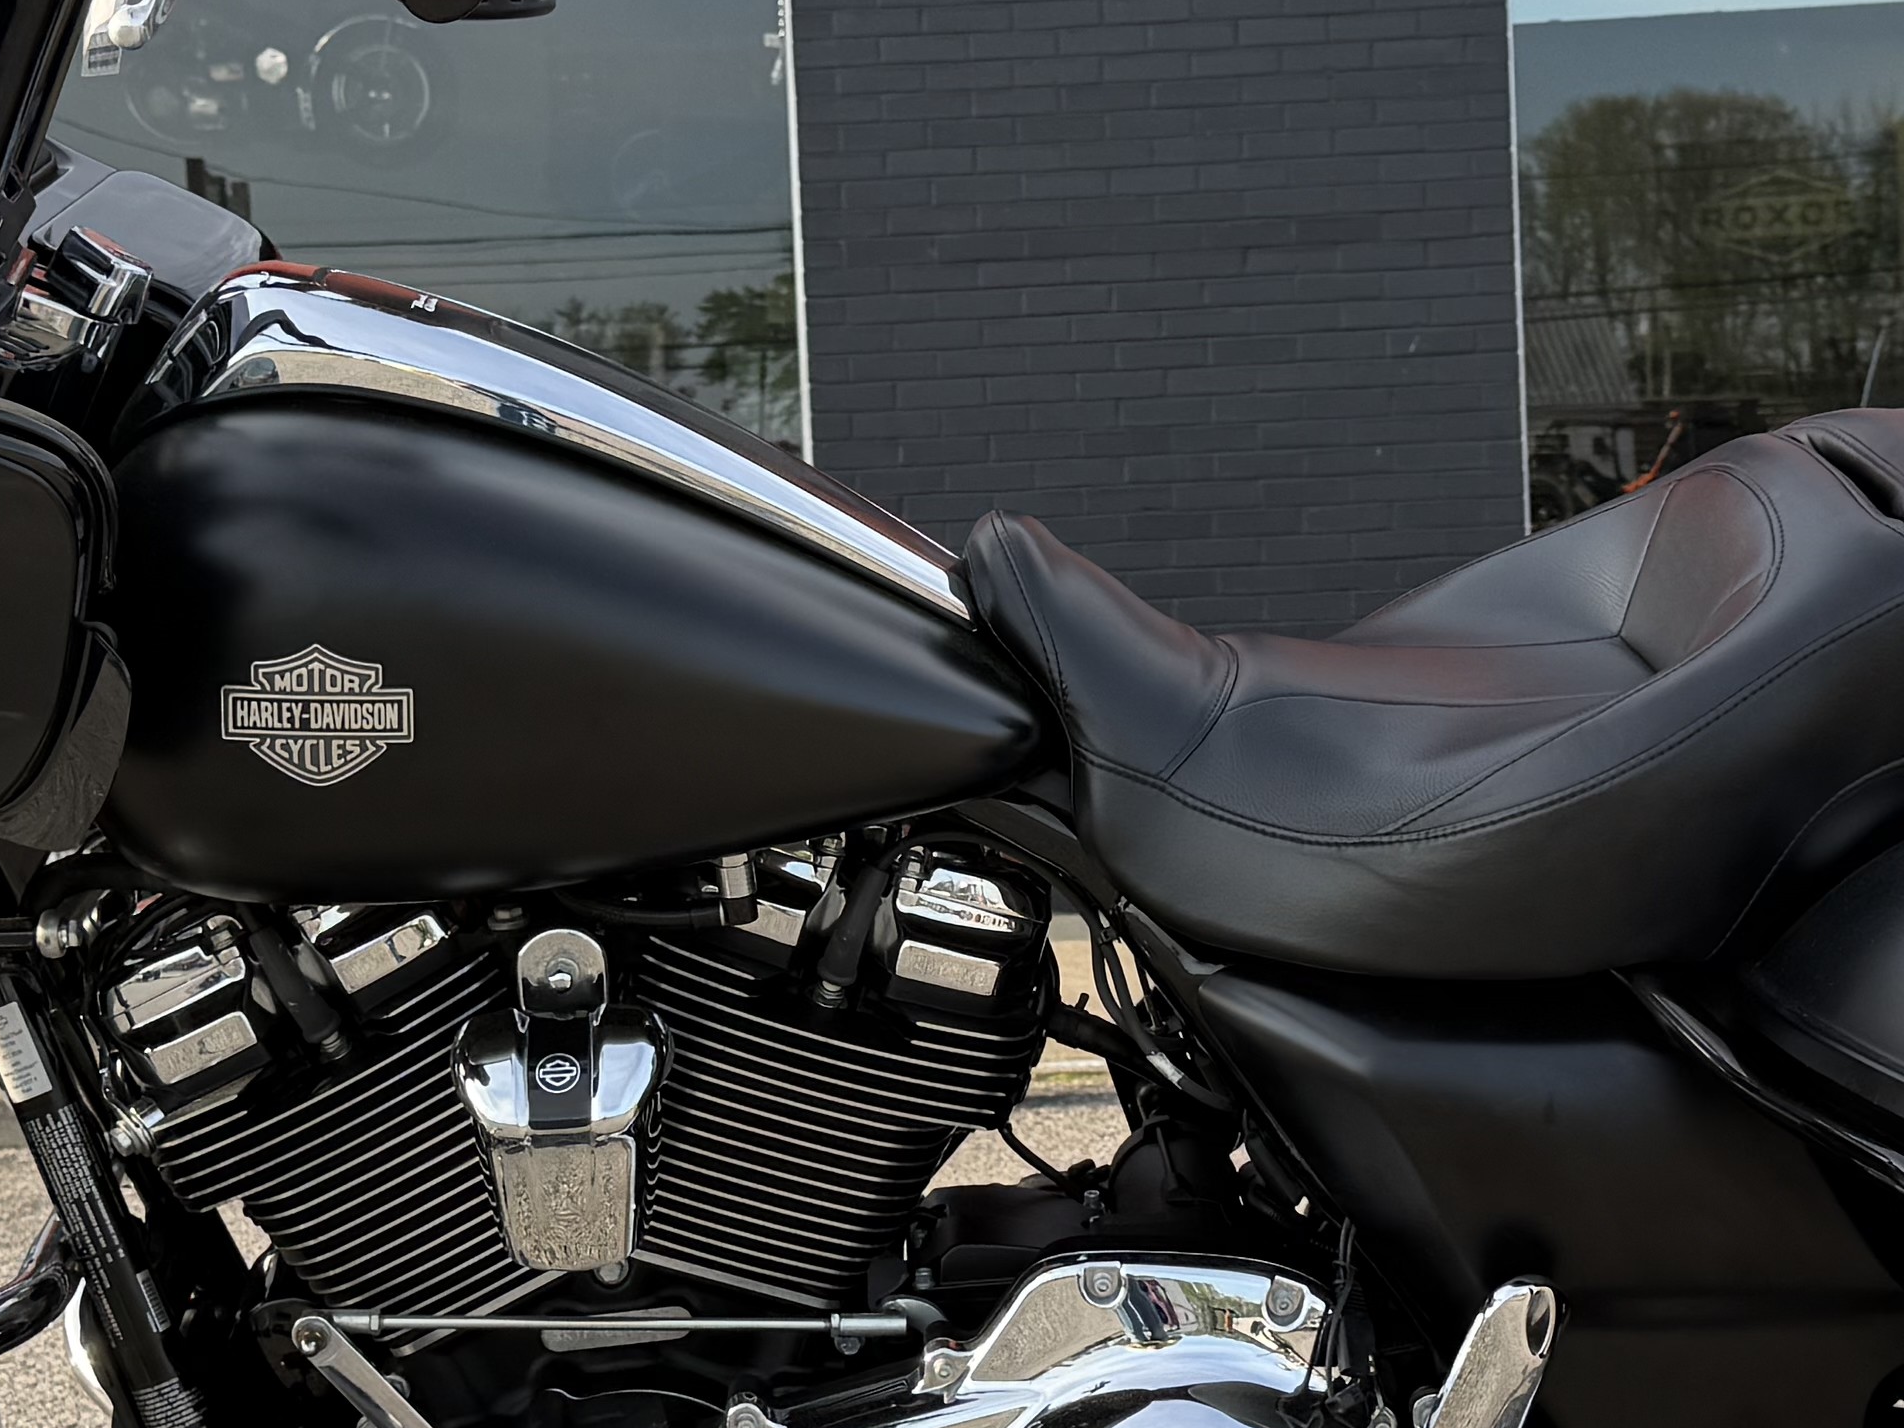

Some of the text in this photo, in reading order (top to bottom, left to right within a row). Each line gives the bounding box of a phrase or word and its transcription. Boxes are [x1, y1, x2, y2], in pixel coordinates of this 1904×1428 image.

[274, 661, 360, 693] MOTOR
[236, 699, 399, 730] HARLEY-DAVIDSON
[274, 738, 361, 773] CYCLES
